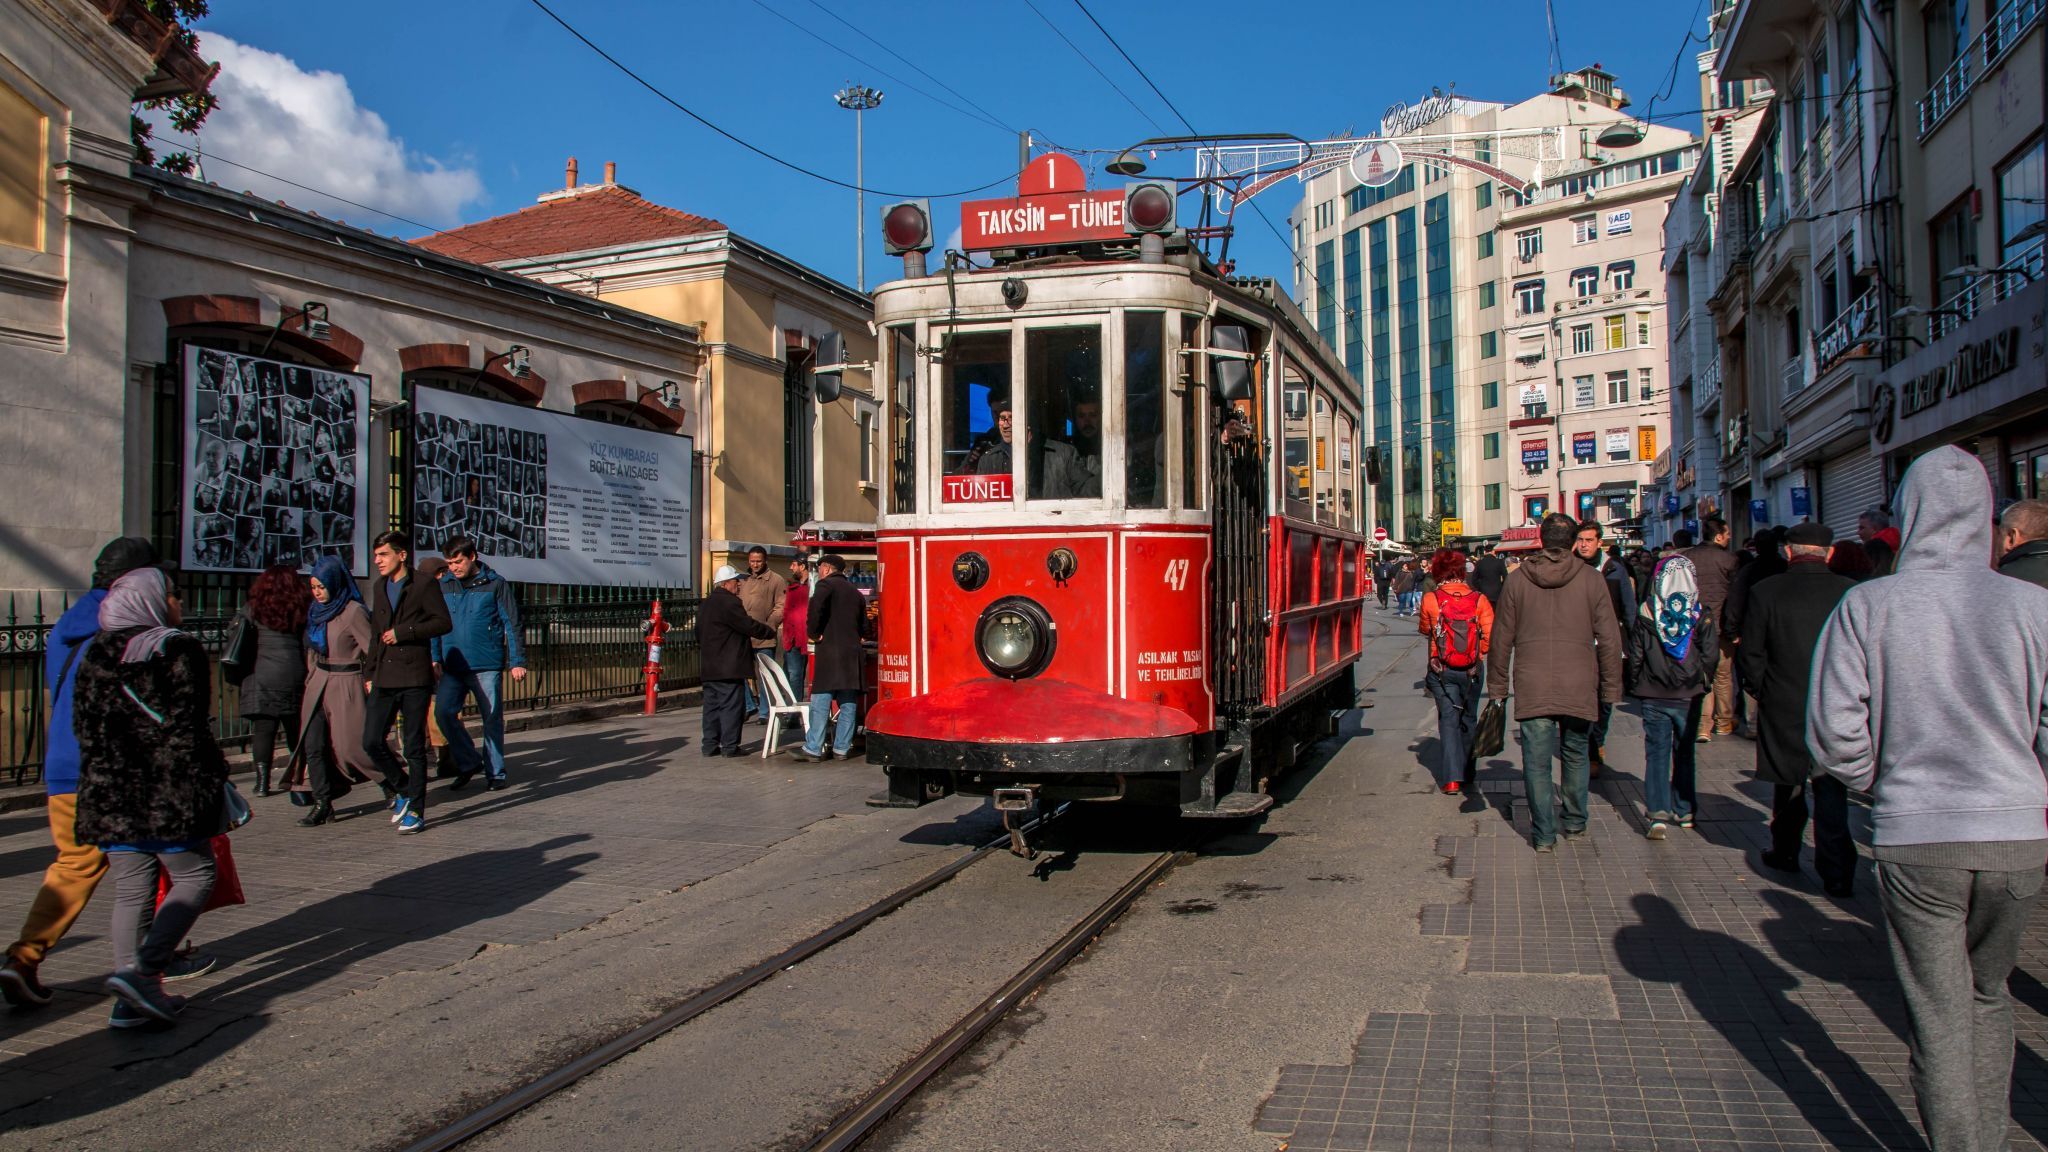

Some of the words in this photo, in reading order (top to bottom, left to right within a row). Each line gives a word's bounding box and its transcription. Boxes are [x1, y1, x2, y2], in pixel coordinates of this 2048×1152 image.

[1047, 158, 1055, 189] 1
[977, 202, 1045, 236] TAKSİM
[1614, 212, 1631, 223] AED
[589, 439, 606, 457] YÜZ
[608, 445, 659, 465] KUMBARASI
[589, 457, 616, 476] BOÎTE
[624, 464, 659, 482] VISAGES
[947, 478, 1011, 500] TÜNEL
[1164, 559, 1190, 591] 47
[1138, 651, 1178, 665] ASILMAK
[1138, 669, 1151, 682] VE
